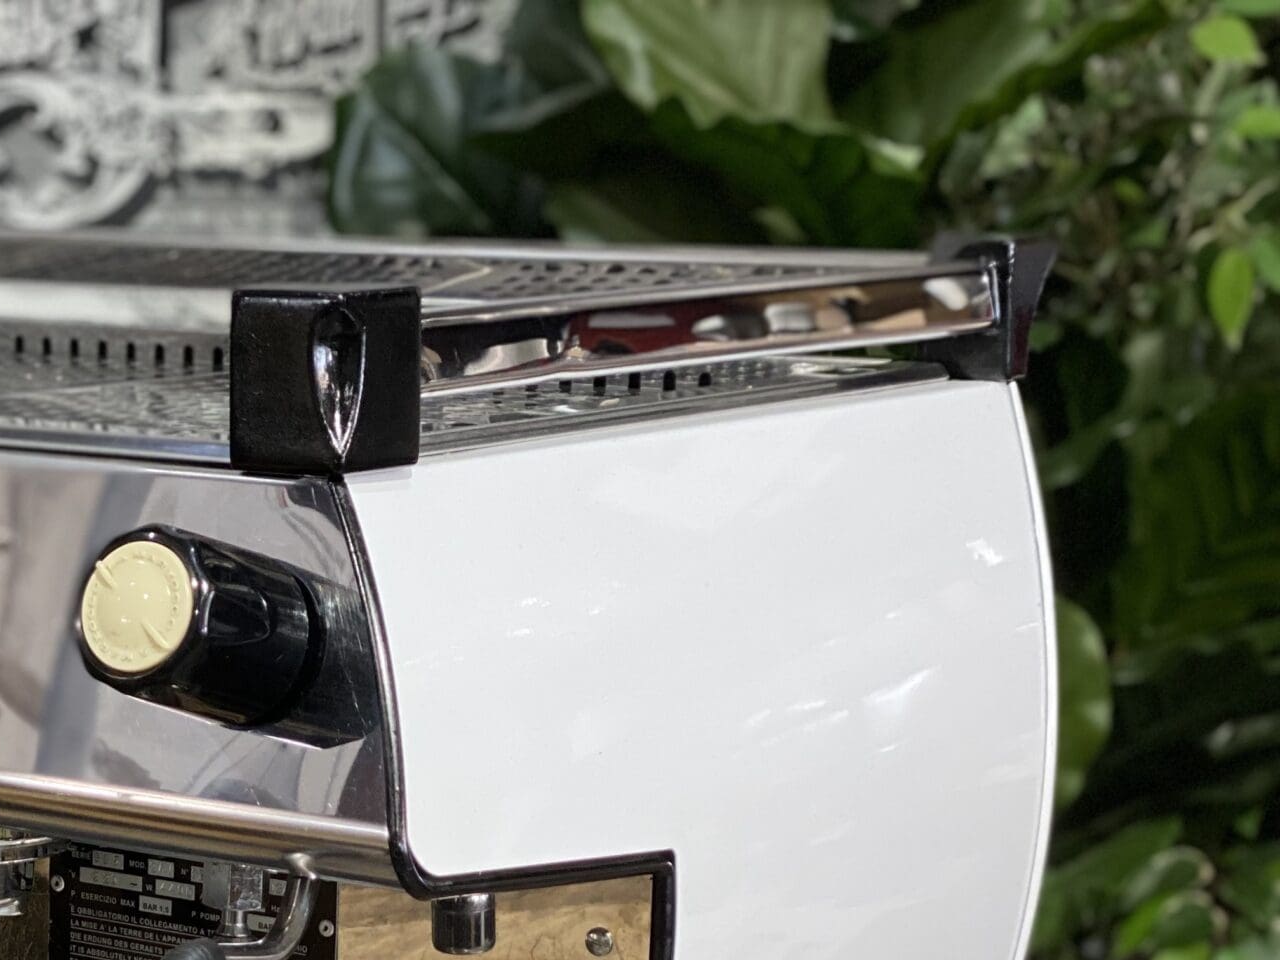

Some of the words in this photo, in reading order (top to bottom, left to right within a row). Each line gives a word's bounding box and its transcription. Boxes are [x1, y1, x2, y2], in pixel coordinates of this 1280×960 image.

[81, 892, 117, 905] ESERCIZIO
[120, 898, 136, 908] MAX
[142, 902, 158, 911] BAR
[70, 918, 80, 927] LA
[81, 919, 98, 930] MISE
[108, 924, 118, 934] LA
[120, 928, 143, 939] TERRE
[144, 931, 154, 941] DE
[77, 906, 129, 923] OBBLIGATORIO
[139, 917, 198, 934] COLLEGAMENTO
[83, 933, 112, 947] ERDUNG
[114, 939, 129, 949] DES
